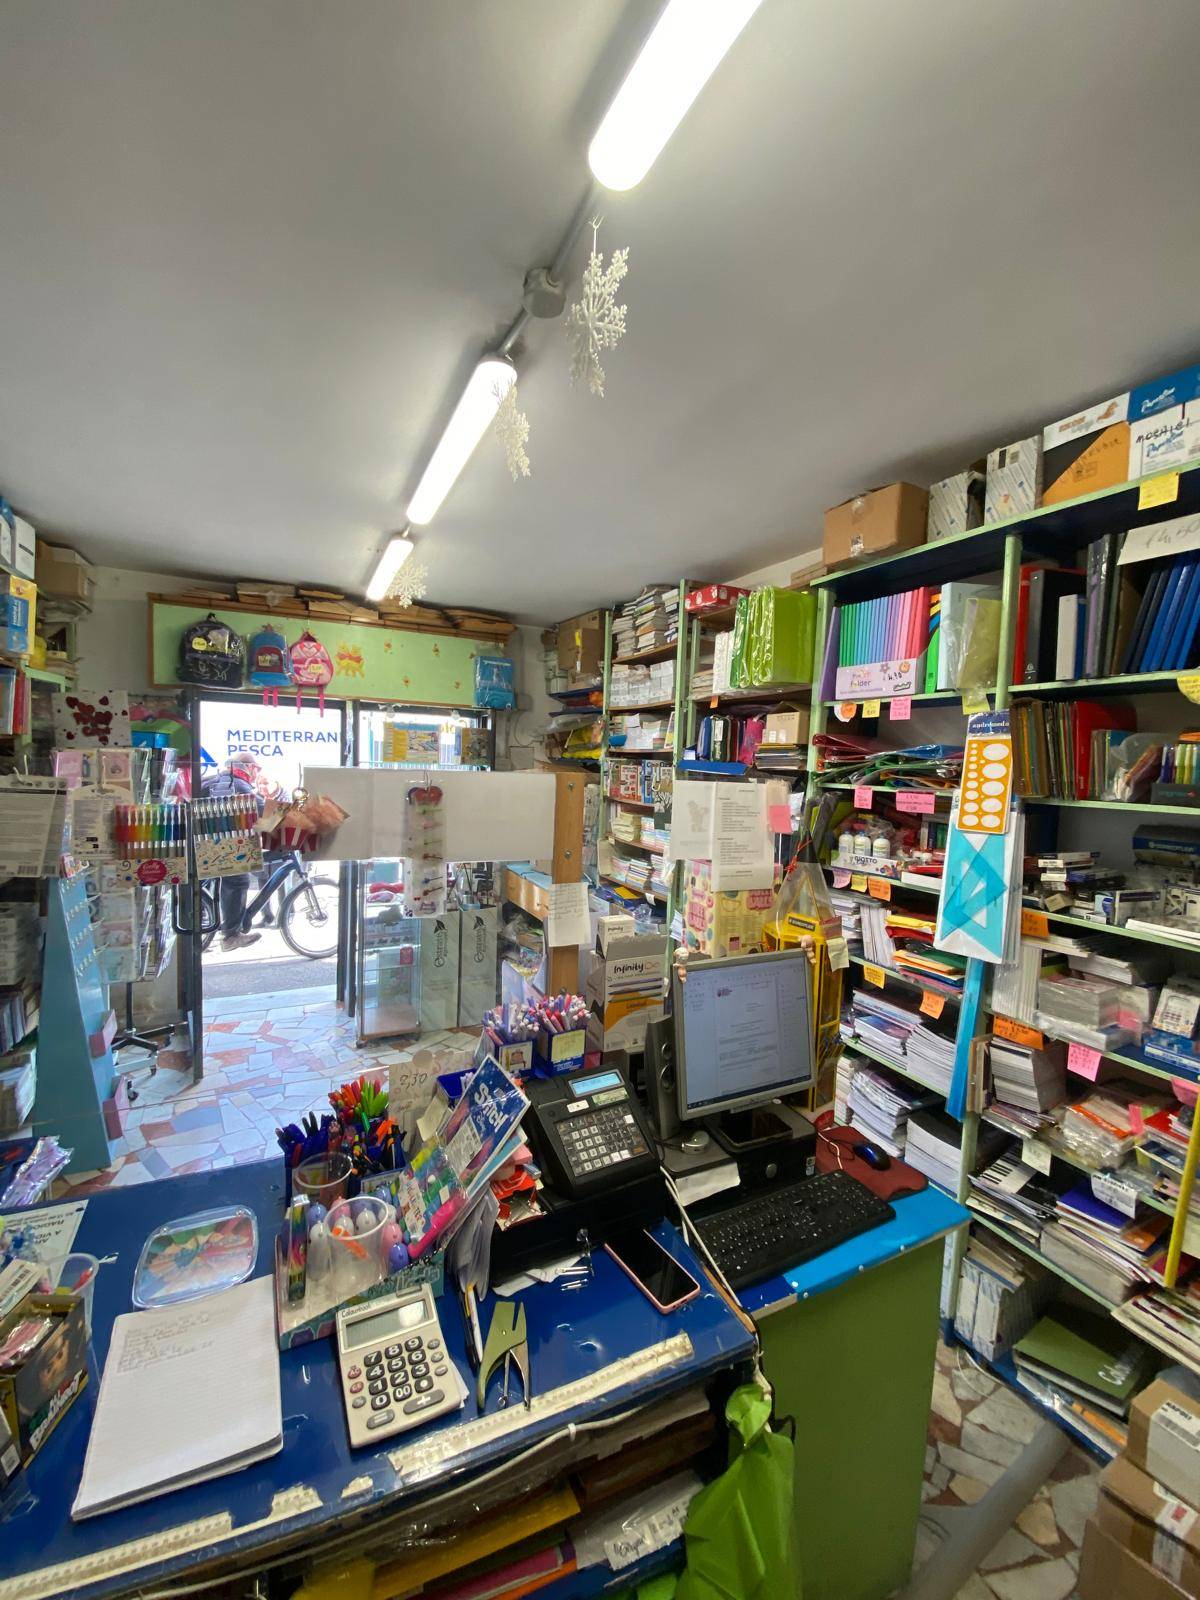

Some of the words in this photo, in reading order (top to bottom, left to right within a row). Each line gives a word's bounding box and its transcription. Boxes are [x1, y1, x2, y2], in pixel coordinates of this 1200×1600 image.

[227, 729, 338, 743] MEDITERRAN
[227, 744, 284, 757] PESCA
[613, 962, 644, 974] Infinity
[399, 1072, 428, 1090] 2,30
[368, 1352, 378, 1363] 7
[388, 1345, 400, 1356] 8
[408, 1338, 419, 1348] 9
[370, 1365, 382, 1376] 4
[392, 1357, 403, 1369] 5
[411, 1350, 423, 1361] 6
[373, 1380, 383, 1390] 1
[394, 1371, 406, 1384] 2
[414, 1364, 427, 1375] 3
[375, 1394, 388, 1406] 0
[395, 1385, 411, 1398] 00
